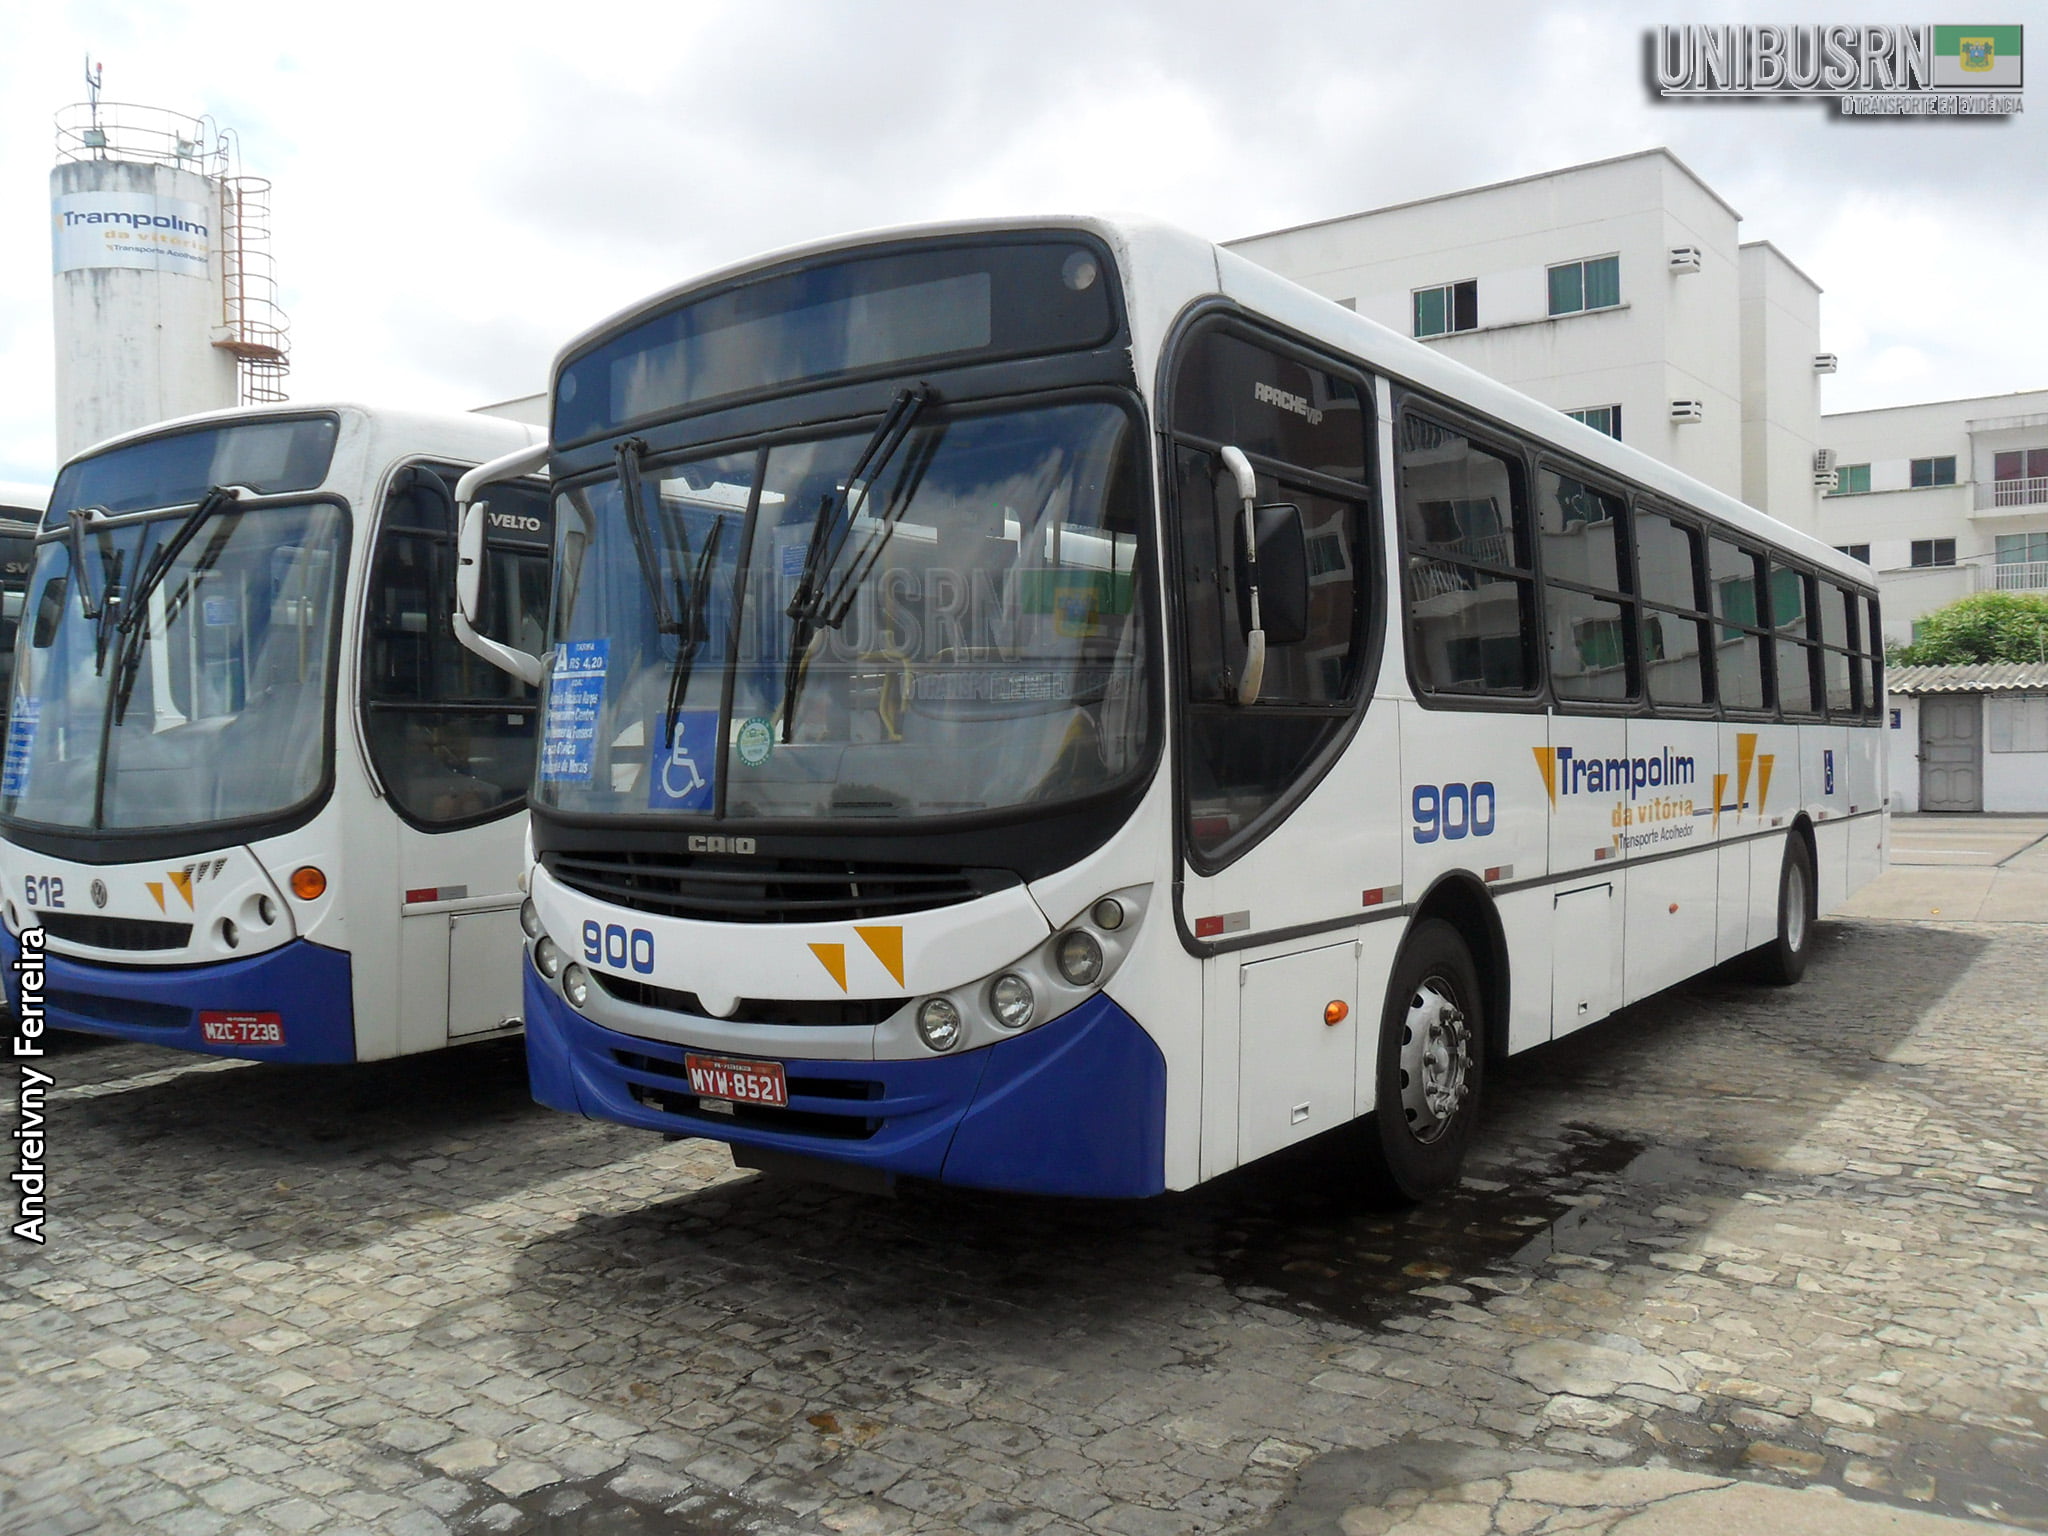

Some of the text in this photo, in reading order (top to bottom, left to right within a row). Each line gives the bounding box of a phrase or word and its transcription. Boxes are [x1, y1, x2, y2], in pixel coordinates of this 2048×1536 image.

[64, 211, 208, 237] Trampolim
[105, 230, 130, 239] da
[113, 244, 165, 255] Transporte
[487, 513, 541, 531] VELTO
[1557, 746, 1694, 800] Trampolim
[1412, 781, 1495, 844] 900
[1611, 795, 1694, 827] da vitória
[688, 835, 756, 854] CAIO
[1619, 822, 1694, 850] Transporte Acolhedor
[25, 875, 65, 907] 612
[583, 919, 655, 975] 900
